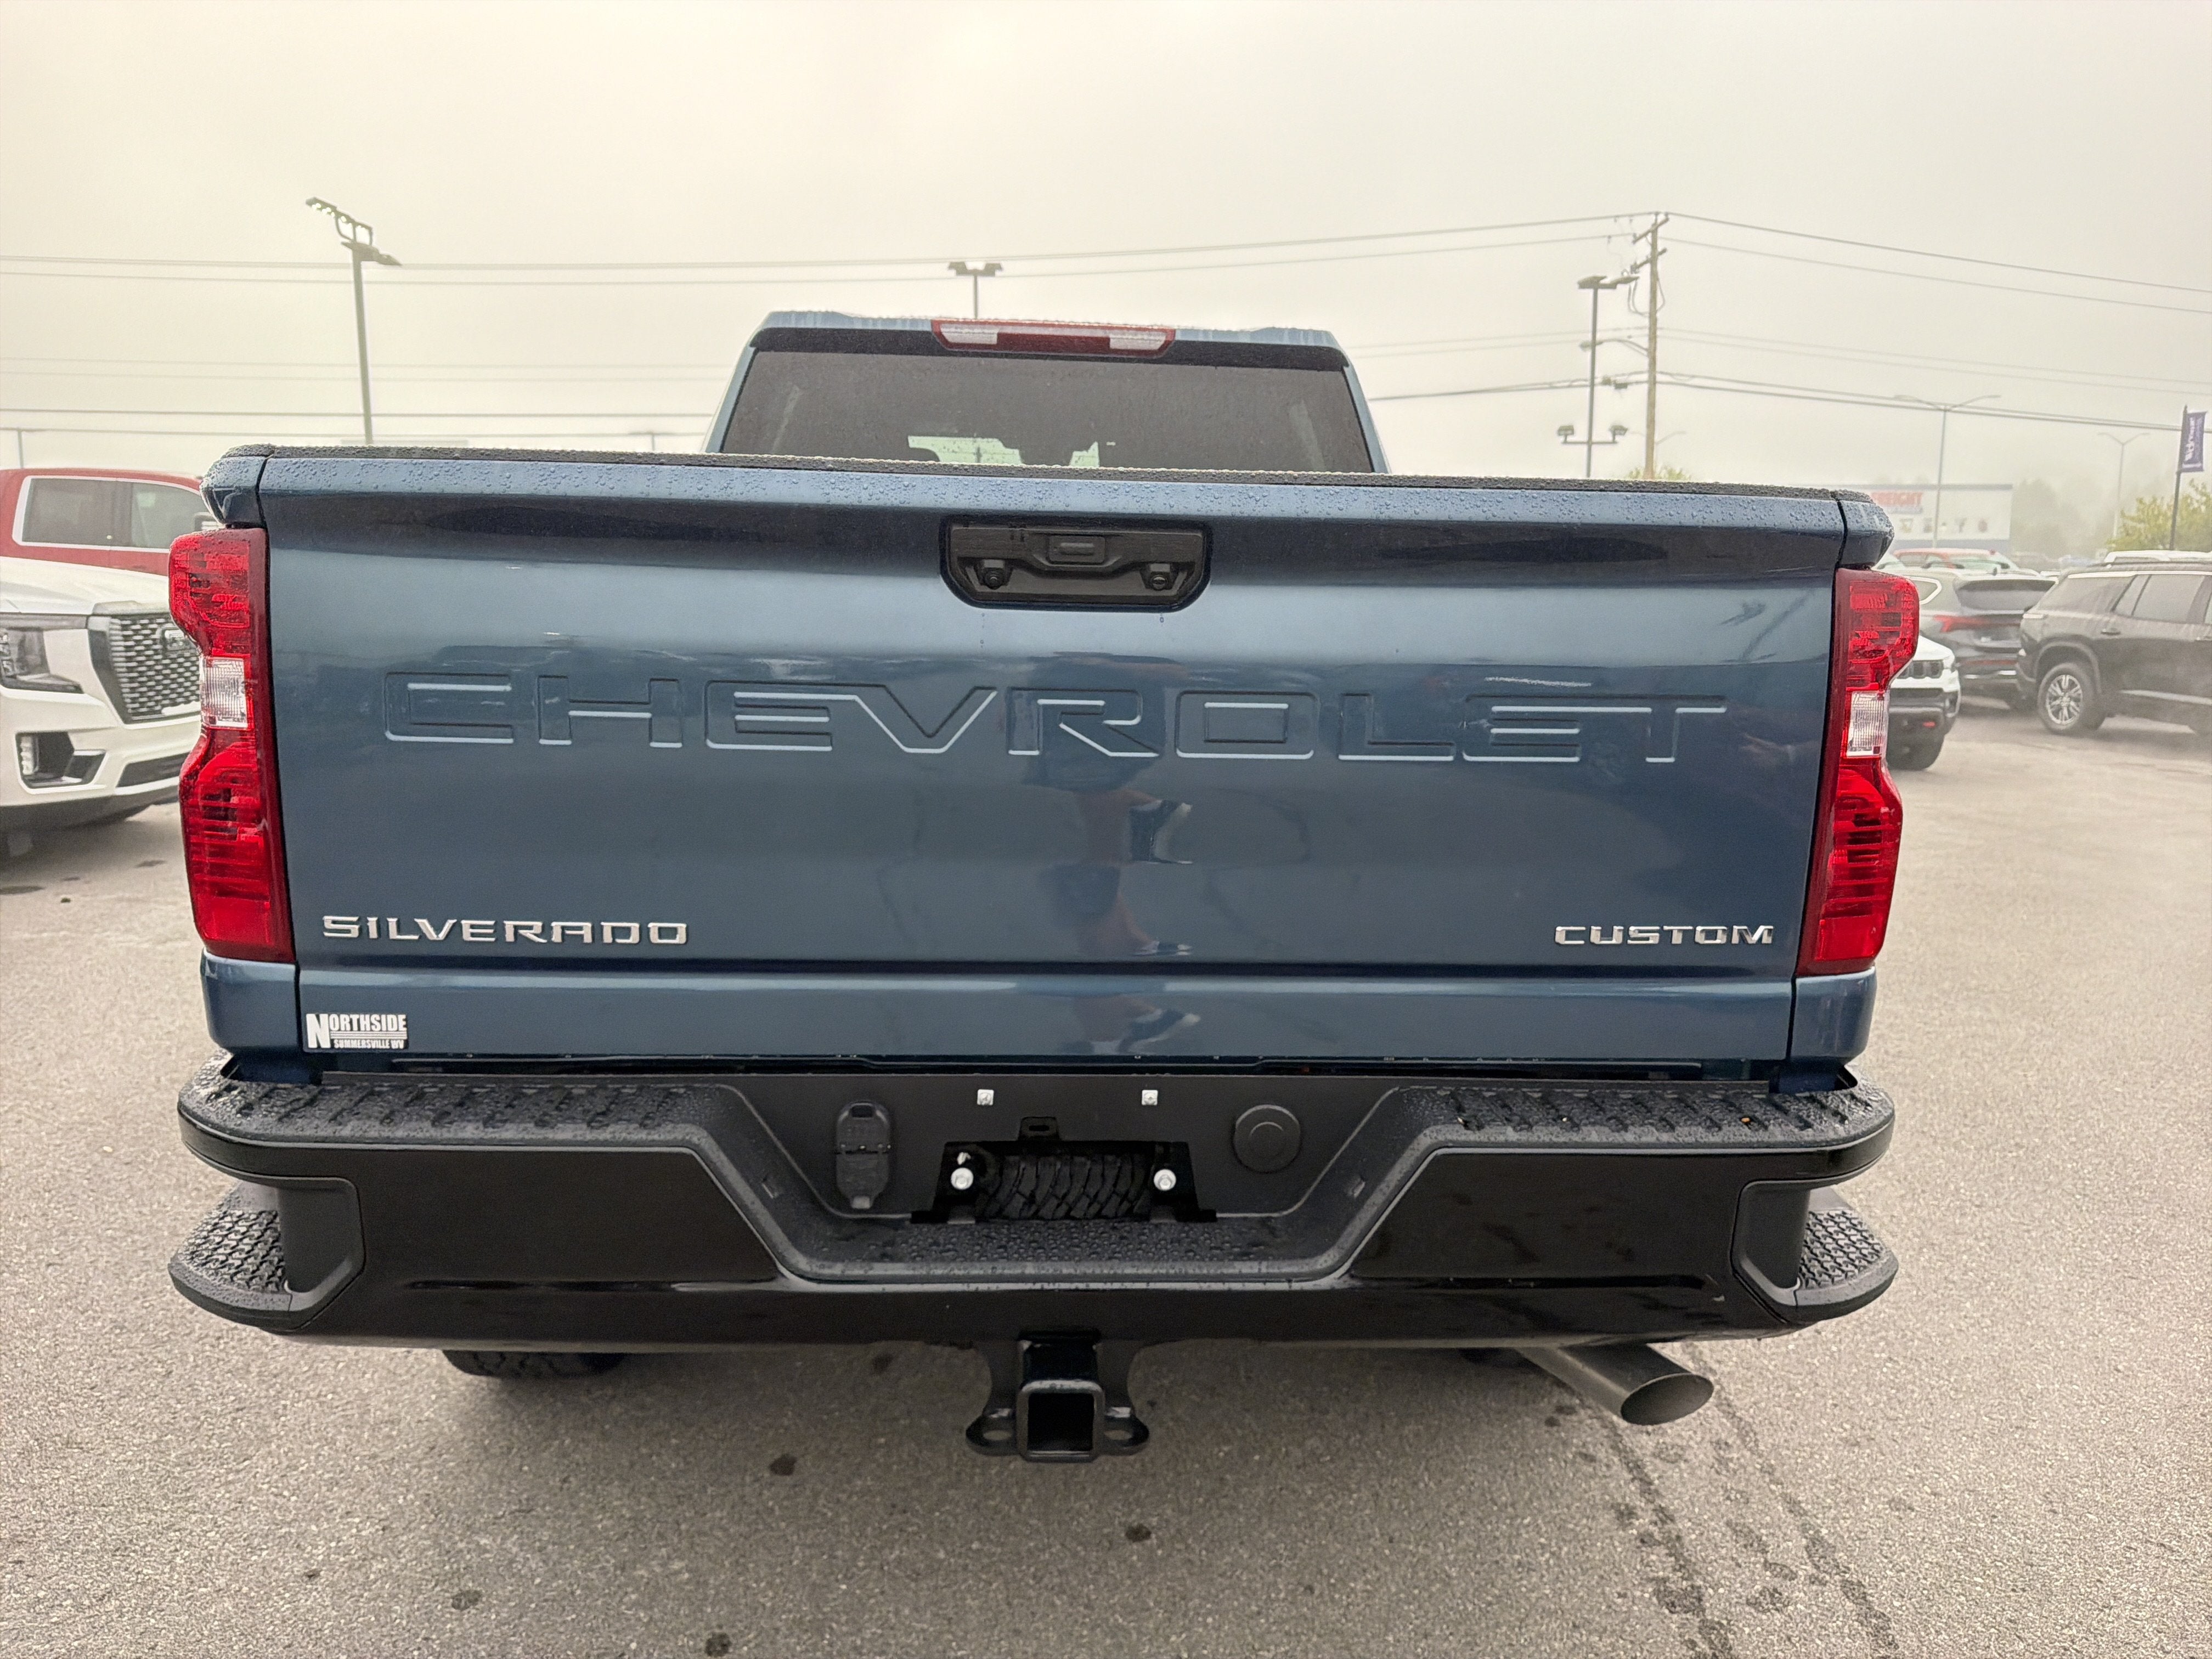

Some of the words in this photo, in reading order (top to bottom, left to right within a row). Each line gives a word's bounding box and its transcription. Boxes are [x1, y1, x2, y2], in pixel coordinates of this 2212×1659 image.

[383, 672, 1728, 763] CHEVROLET
[323, 915, 687, 944] SILVERADO
[1555, 925, 1774, 945] CUSTOM
[306, 1013, 407, 1048] NORTHSIDE
[333, 1039, 390, 1049] SUMMERSVILLE
[391, 1040, 404, 1049] WV
